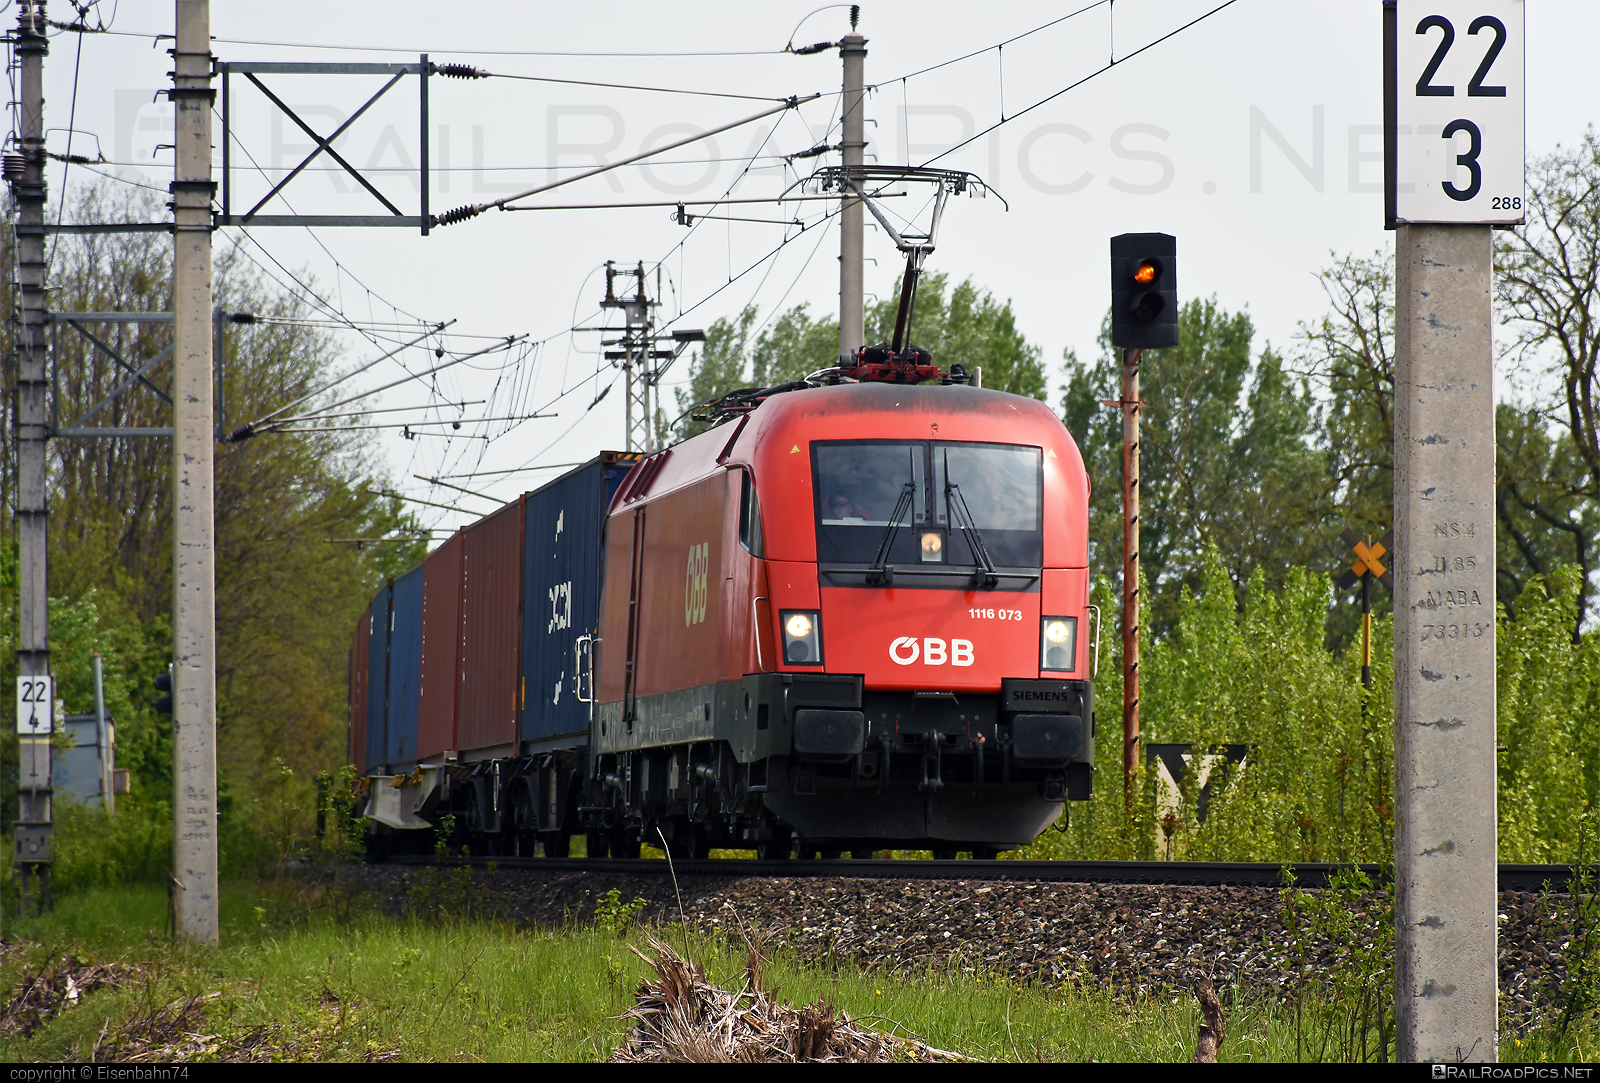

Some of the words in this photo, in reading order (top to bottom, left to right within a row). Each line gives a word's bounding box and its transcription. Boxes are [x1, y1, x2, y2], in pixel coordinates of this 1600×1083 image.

[1415, 14, 1507, 97] 22
[1441, 118, 1482, 201] 3
[1491, 197, 1522, 210] 288
[685, 542, 709, 628] ÖBB
[968, 608, 995, 619] 1116
[998, 609, 1022, 621] 073
[888, 636, 975, 667] ÖBB
[22, 681, 46, 702] 22
[1012, 690, 1068, 702] SIEMENS
[29, 707, 40, 728] 4
